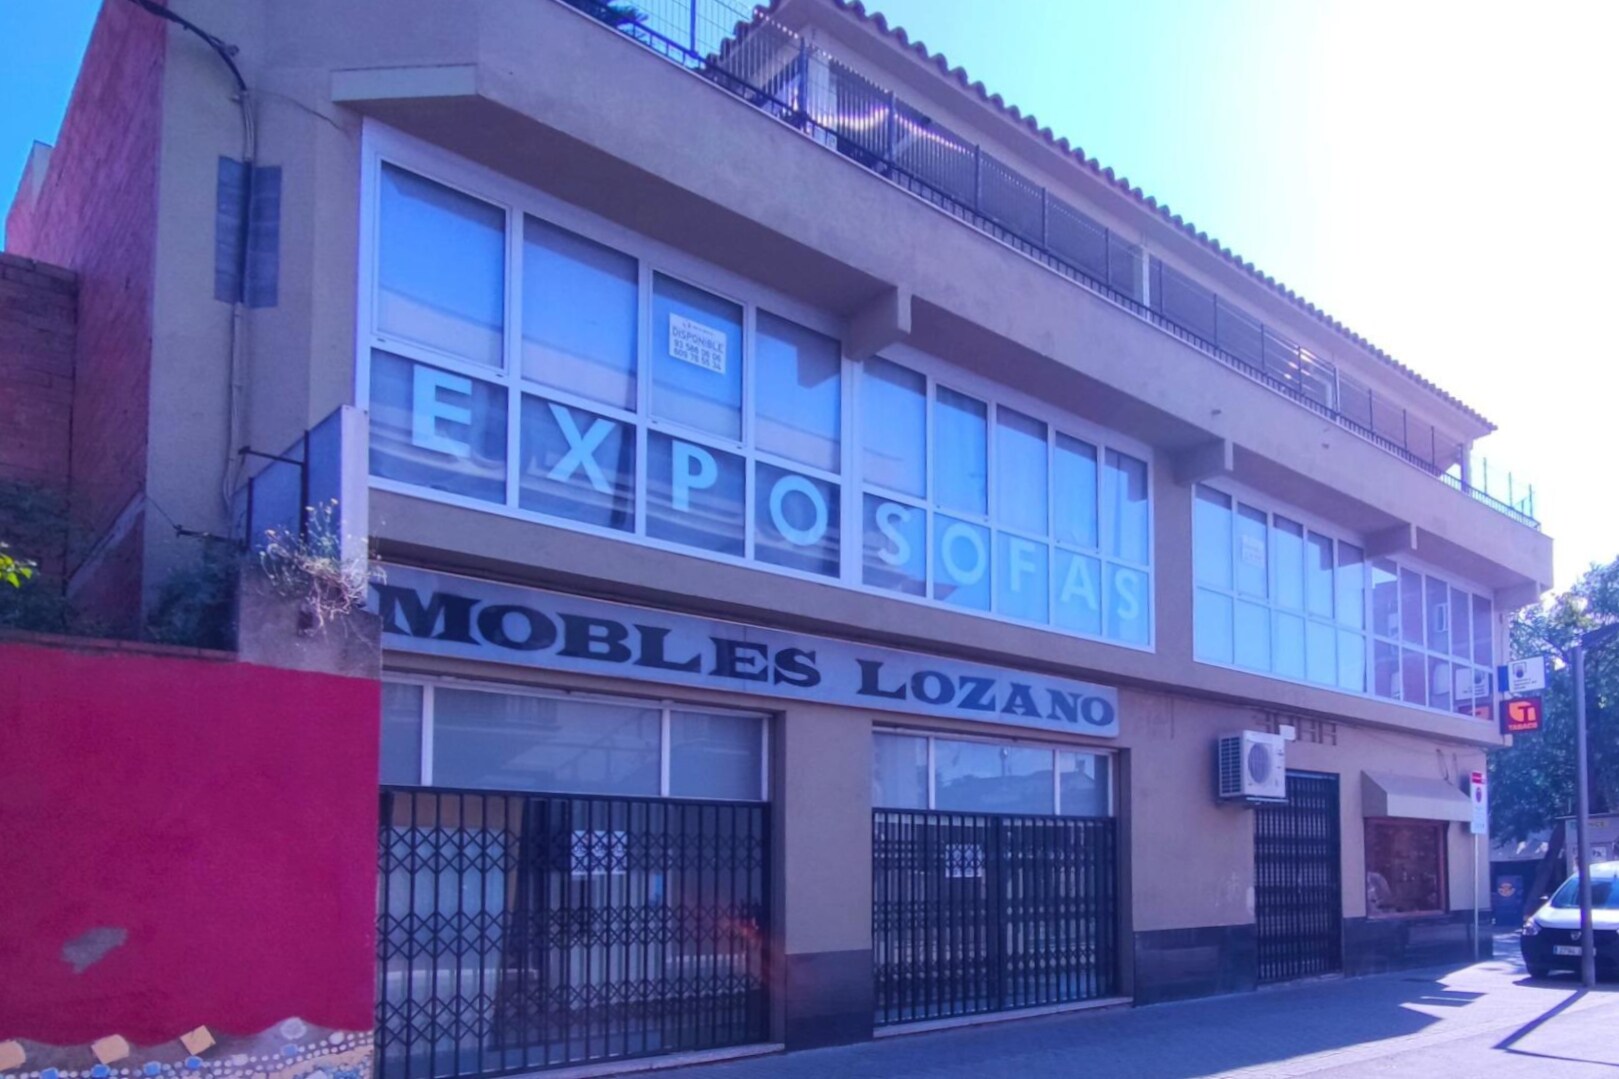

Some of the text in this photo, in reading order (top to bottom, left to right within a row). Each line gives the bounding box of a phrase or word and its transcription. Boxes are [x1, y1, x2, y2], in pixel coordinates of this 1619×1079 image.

[672, 326, 724, 353] DISPONIBLE
[411, 363, 1140, 620] EXPO SOFAS
[370, 581, 1116, 727] MOBLES LOZANO
